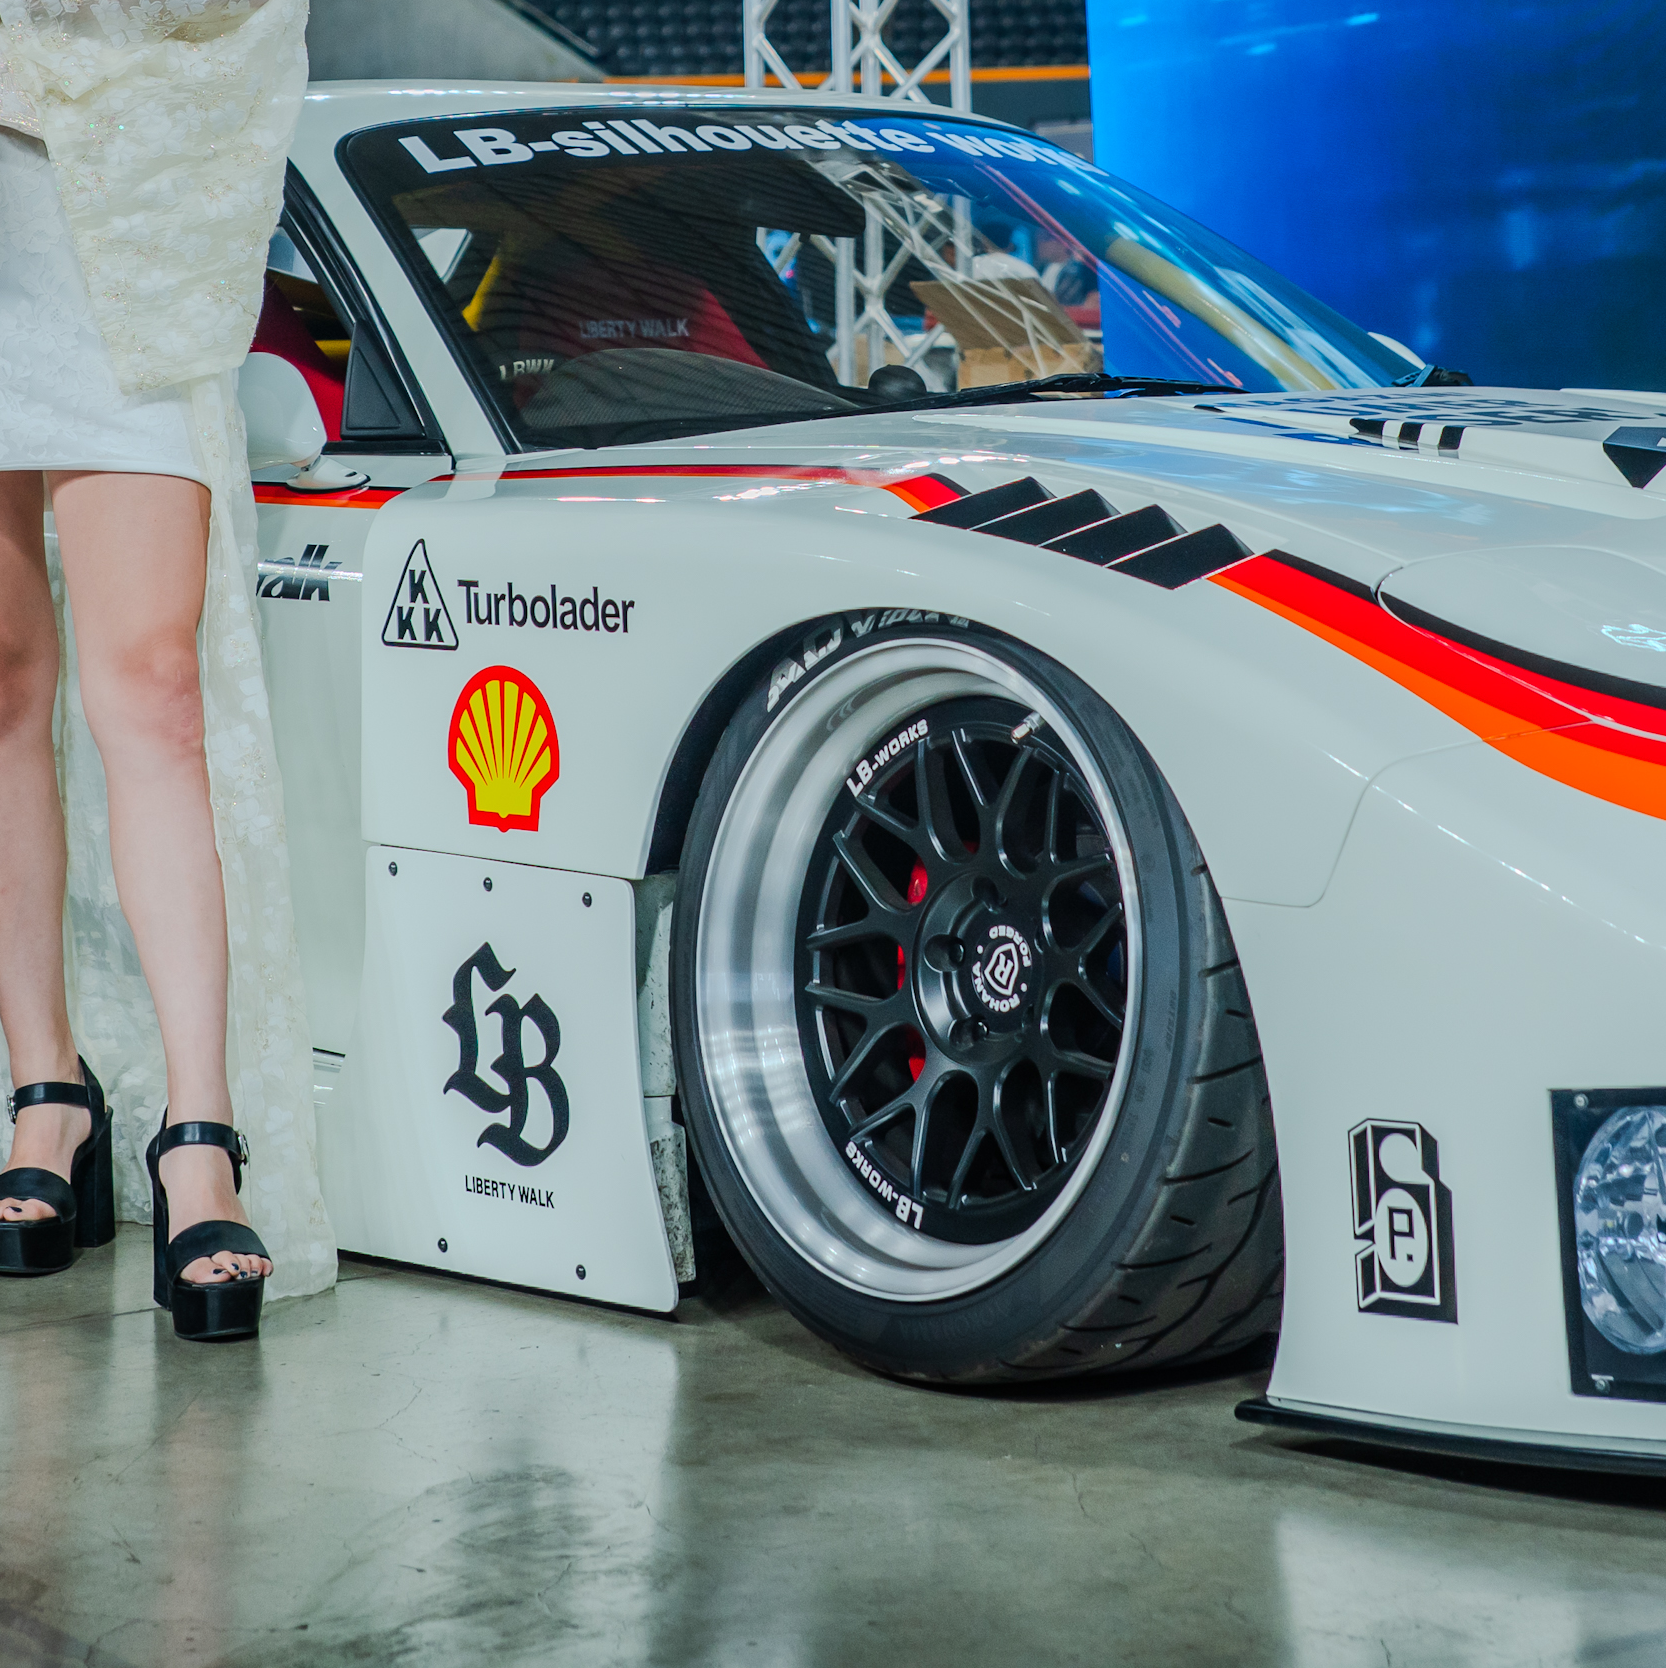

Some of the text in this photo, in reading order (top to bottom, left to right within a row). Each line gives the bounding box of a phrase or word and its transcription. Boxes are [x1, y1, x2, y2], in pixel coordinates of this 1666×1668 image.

[397, 118, 936, 174] LB-silhouette
[638, 318, 691, 338] WALK
[457, 578, 636, 634] Turbolader
[845, 718, 929, 799] LB-WORKS
[988, 924, 1032, 968] FORGED
[972, 960, 1021, 1013] ROHANA
[464, 1174, 555, 1210] LIBERTY WALK
[844, 1140, 925, 1230] LB-WORKS
